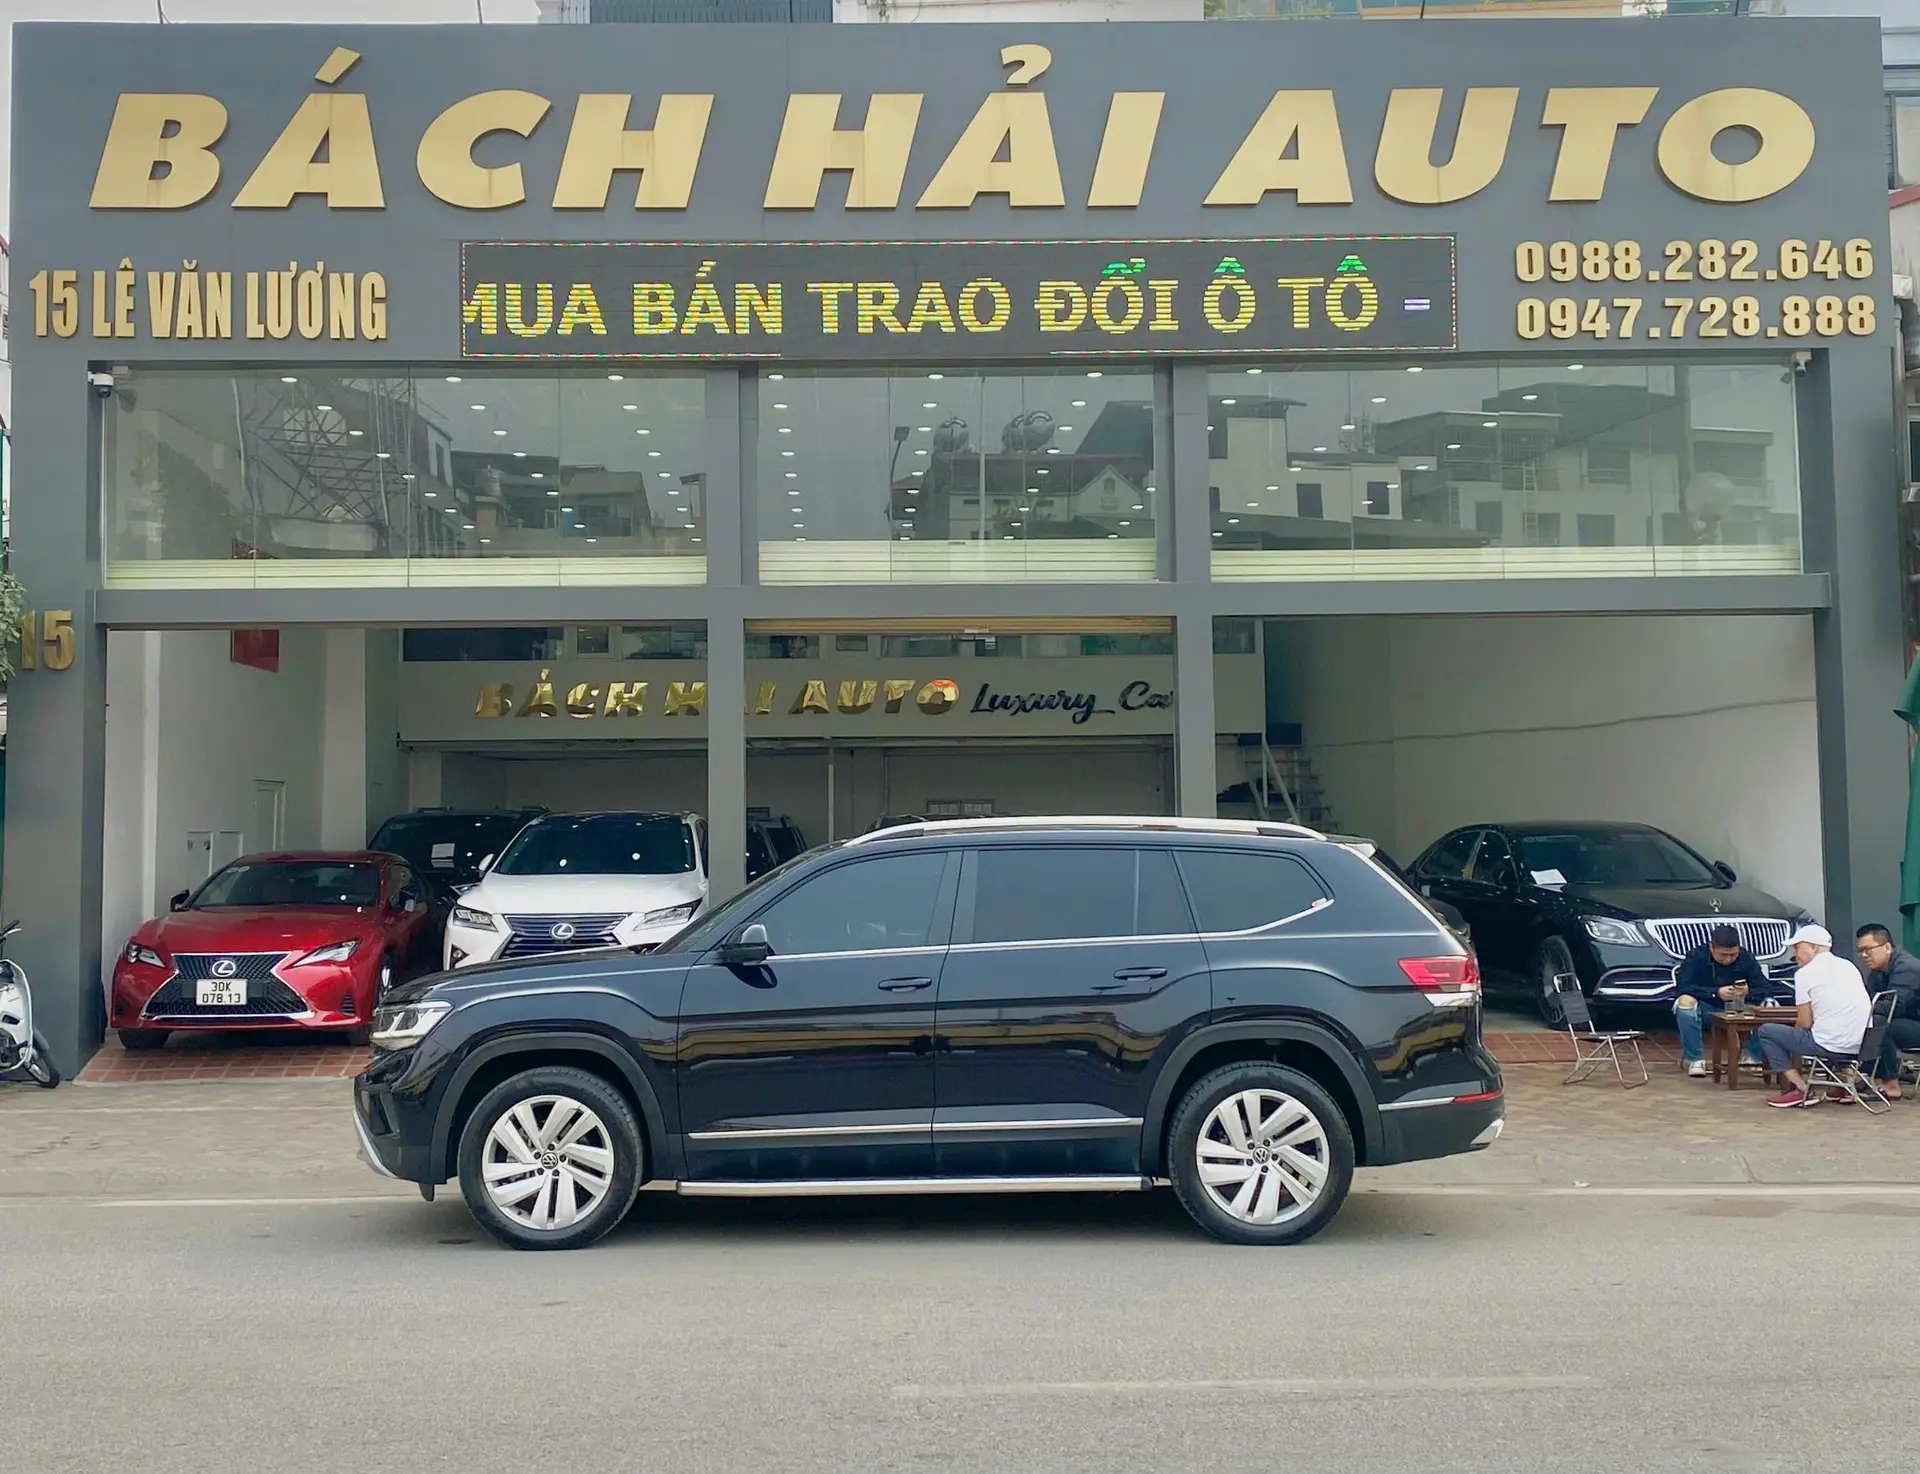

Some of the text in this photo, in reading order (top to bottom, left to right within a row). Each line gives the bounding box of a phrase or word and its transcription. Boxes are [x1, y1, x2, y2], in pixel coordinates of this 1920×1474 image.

[88, 43, 1816, 211] BÁCH HẢI AUTO
[1515, 238, 1875, 283] 0988.282.646
[29, 257, 388, 341] 15 LÊ VĂN LƯƠNG
[633, 260, 782, 335] BÁN
[806, 277, 1011, 334] TRAO
[1034, 256, 1179, 334] ĐỔI
[1203, 256, 1257, 333] Ô
[1277, 254, 1378, 331] TÔ
[1516, 295, 1877, 339] 0947.728.888
[20, 610, 76, 670] 15
[475, 668, 649, 718] BÁCH
[663, 680, 778, 716] HI
[788, 678, 961, 715] AUTO
[202, 992, 241, 1004] 078.13
[211, 981, 232, 992] 30K
